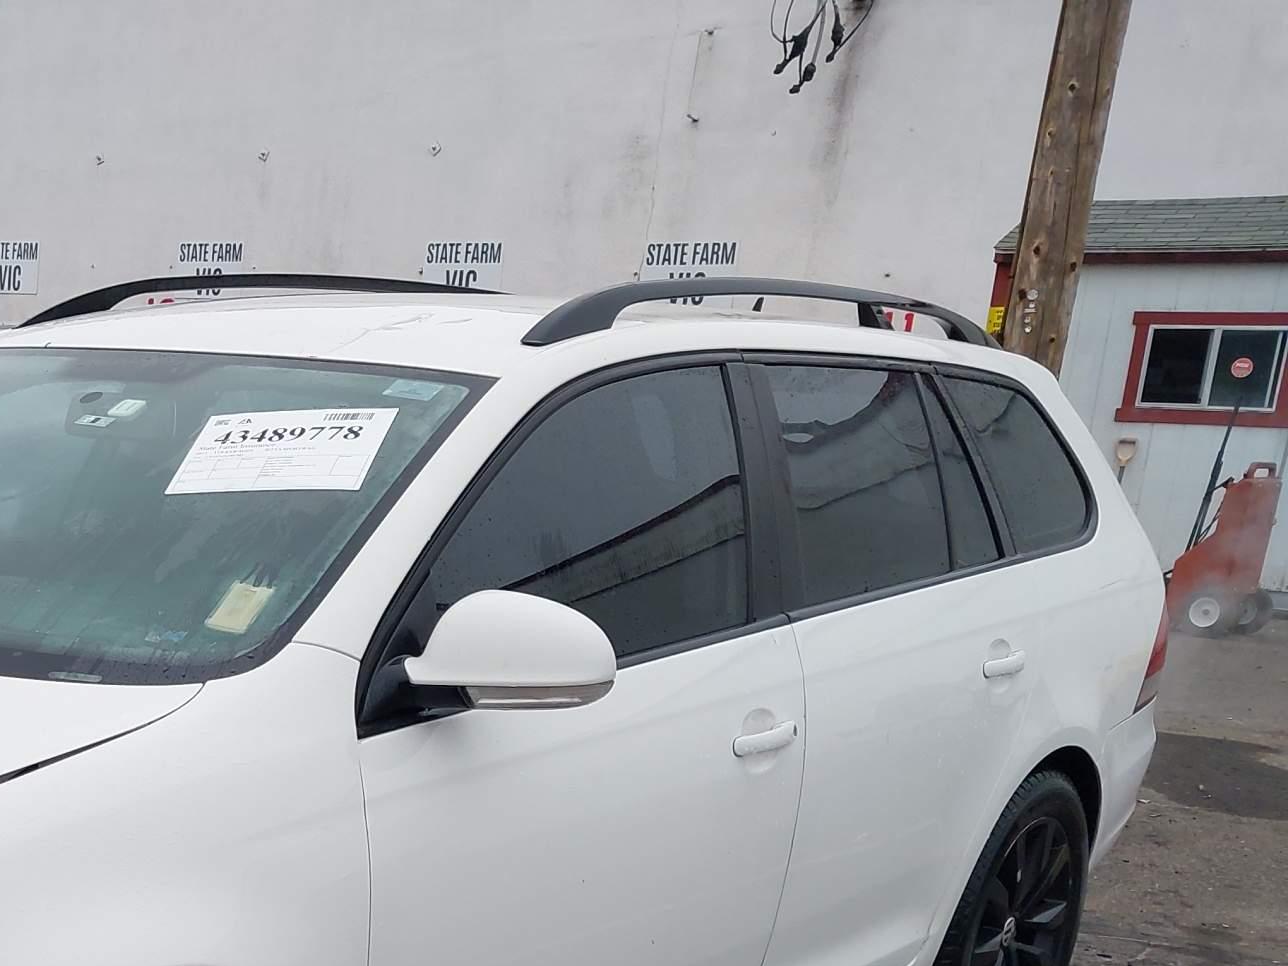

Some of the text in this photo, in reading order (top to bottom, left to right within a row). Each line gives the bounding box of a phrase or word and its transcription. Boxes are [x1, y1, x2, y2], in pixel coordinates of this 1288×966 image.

[12, 242, 38, 260] FARM
[179, 243, 243, 262] STATE FARM
[427, 242, 502, 264] STATE FARM
[646, 242, 737, 266] STATE FARM
[0, 264, 22, 291] VIC
[214, 425, 363, 445] 43489778
